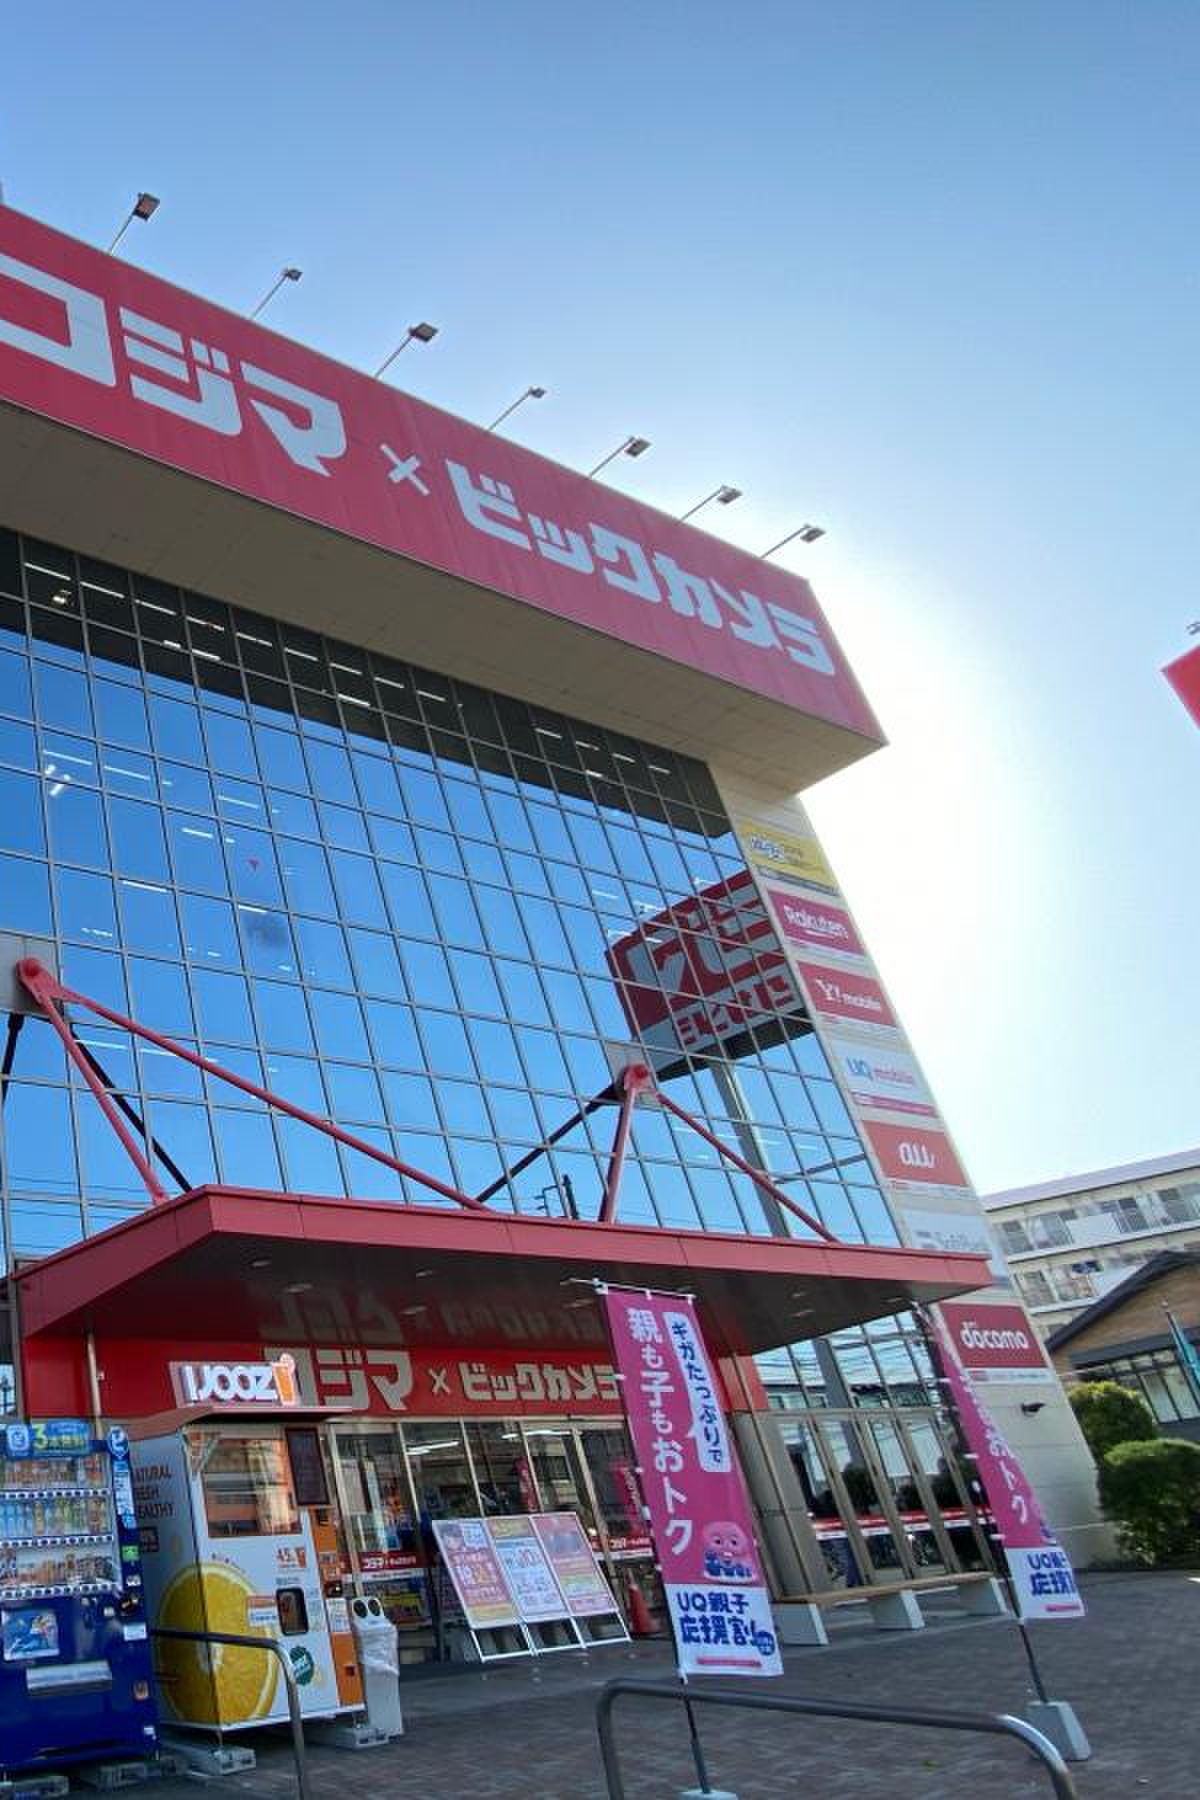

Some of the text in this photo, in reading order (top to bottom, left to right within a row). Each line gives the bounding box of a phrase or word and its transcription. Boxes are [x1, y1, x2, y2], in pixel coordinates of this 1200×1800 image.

[446, 458, 835, 676] ビックカメラ
[899, 1141, 935, 1168] au
[960, 1321, 1029, 1349] docomo
[625, 1306, 693, 1556] 親も子もおトク
[671, 1321, 724, 1465] ギガたっぷりで
[676, 1591, 749, 1616] UQ親子
